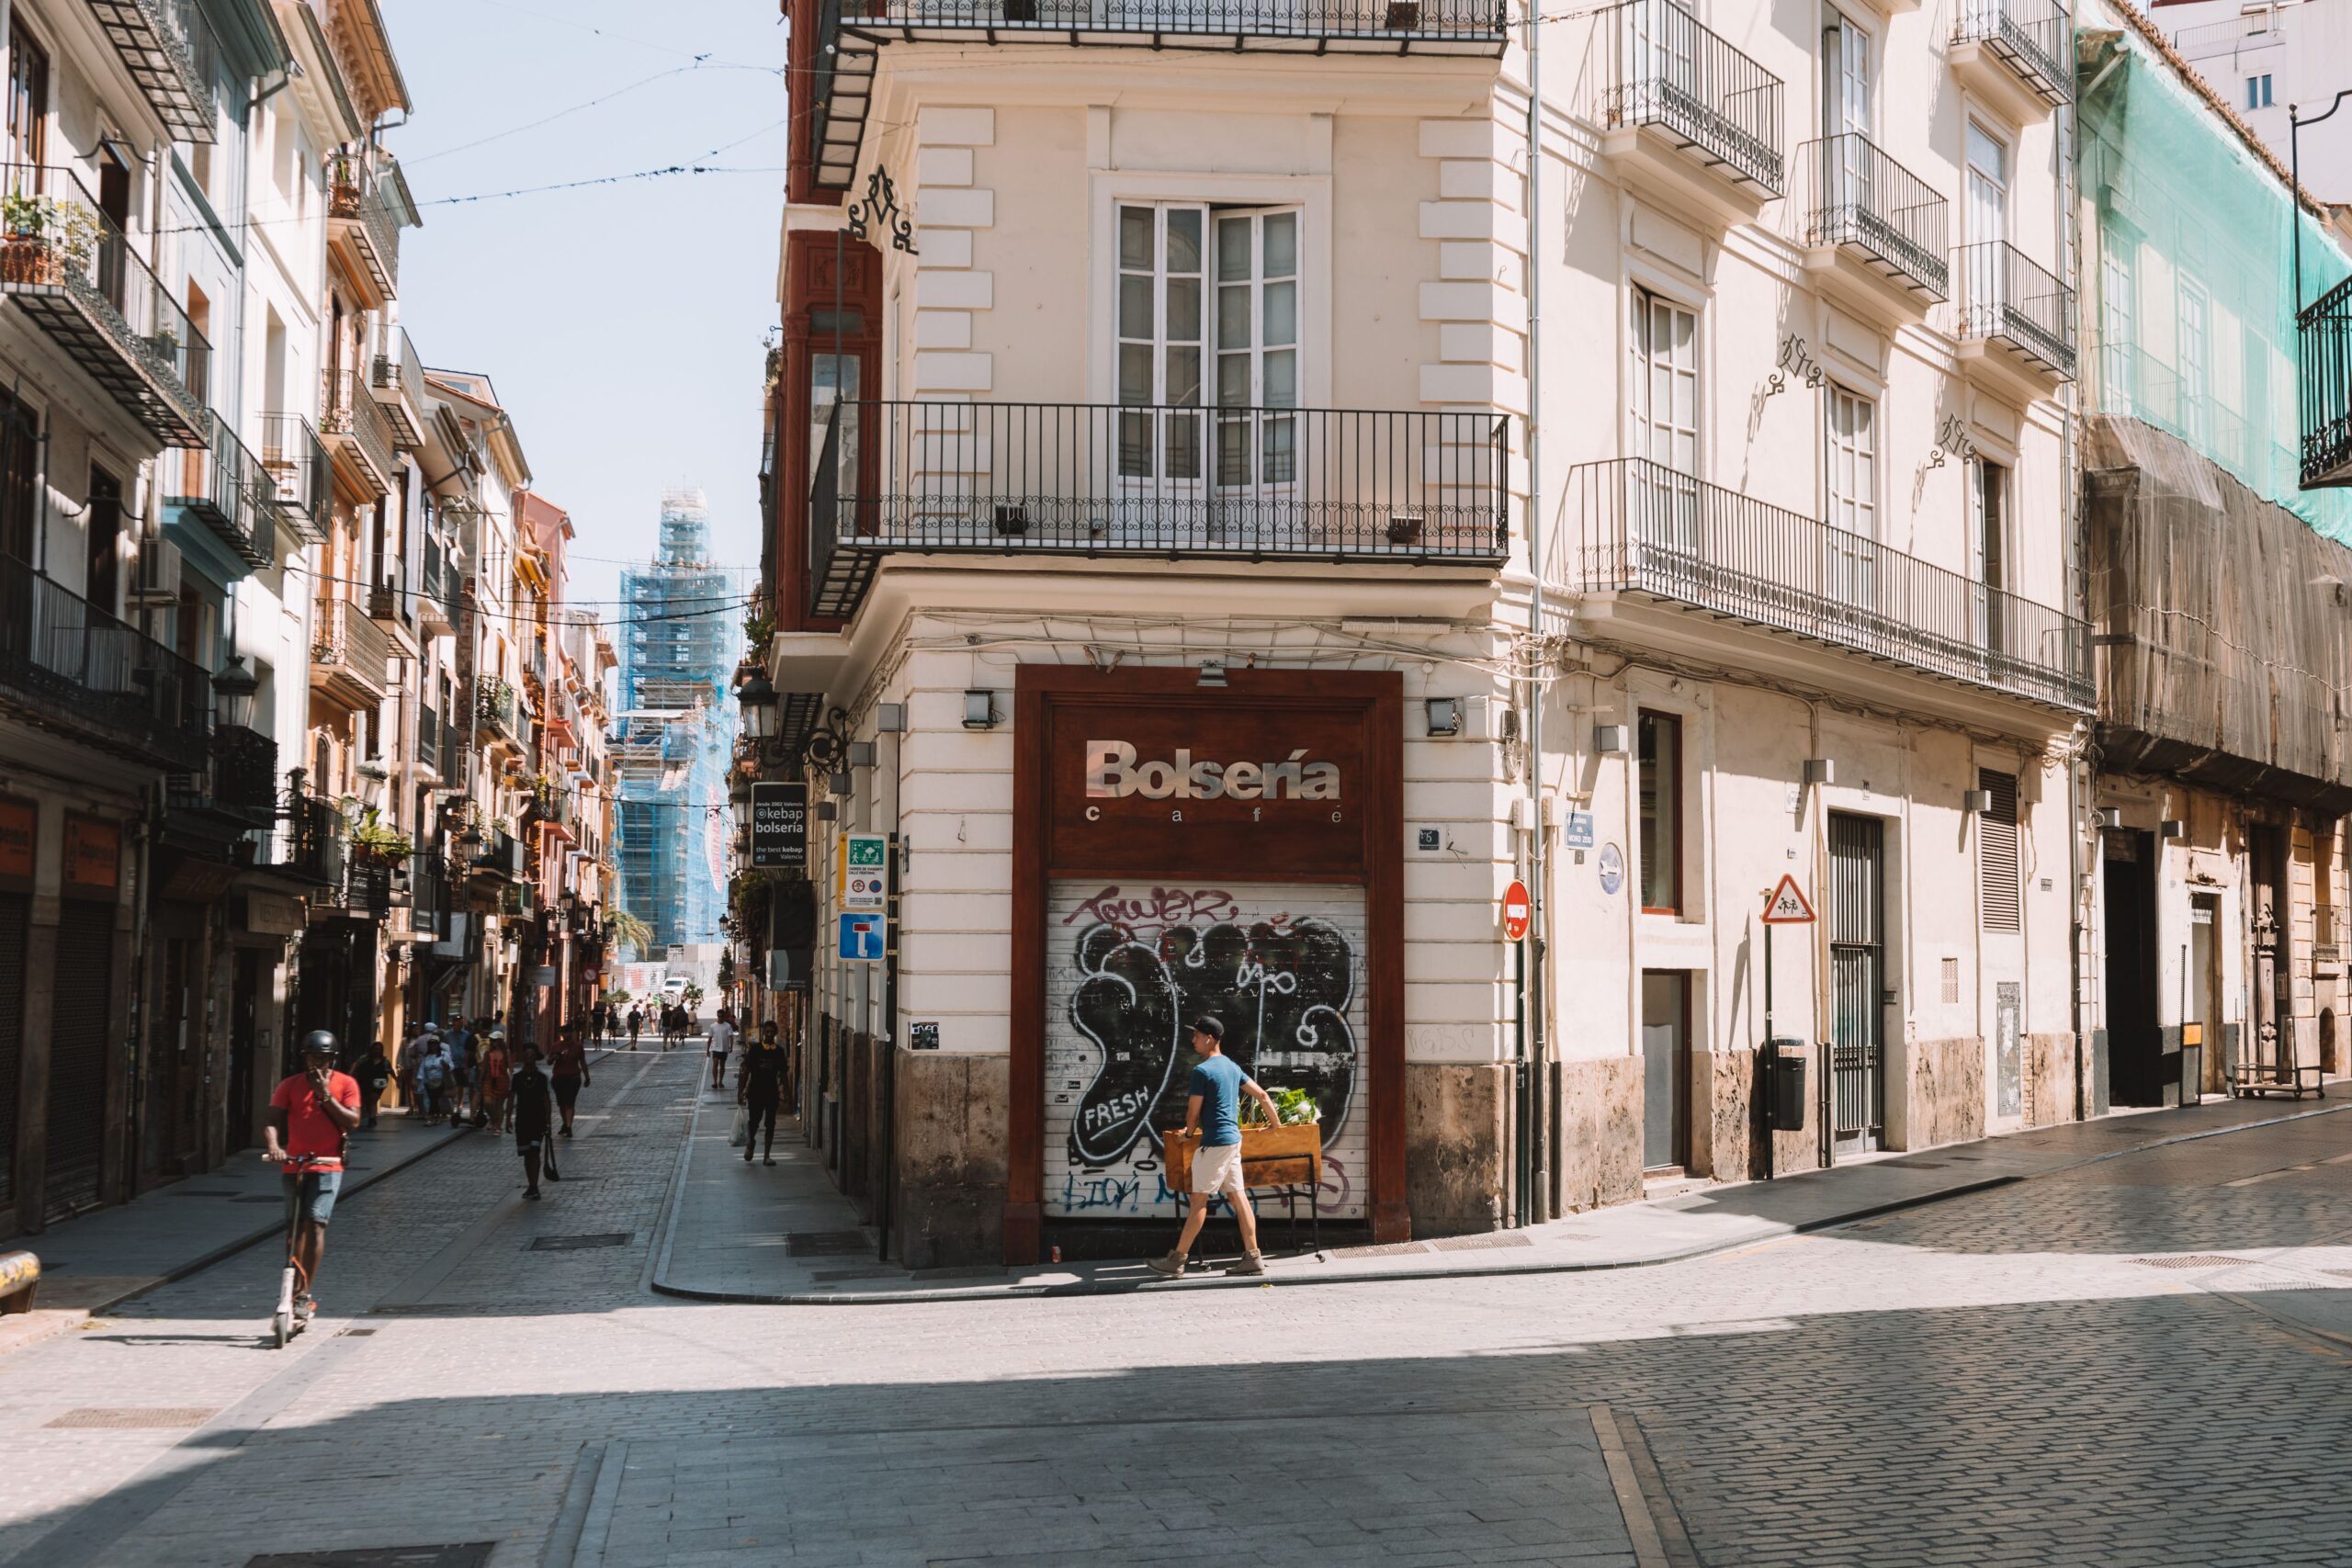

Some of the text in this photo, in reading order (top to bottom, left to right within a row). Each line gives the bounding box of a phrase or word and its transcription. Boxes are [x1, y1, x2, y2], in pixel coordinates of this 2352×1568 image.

[1085, 739, 1341, 800] Bolsería
[755, 821, 803, 833] bolsería
[1085, 1085, 1149, 1131] FRESH
